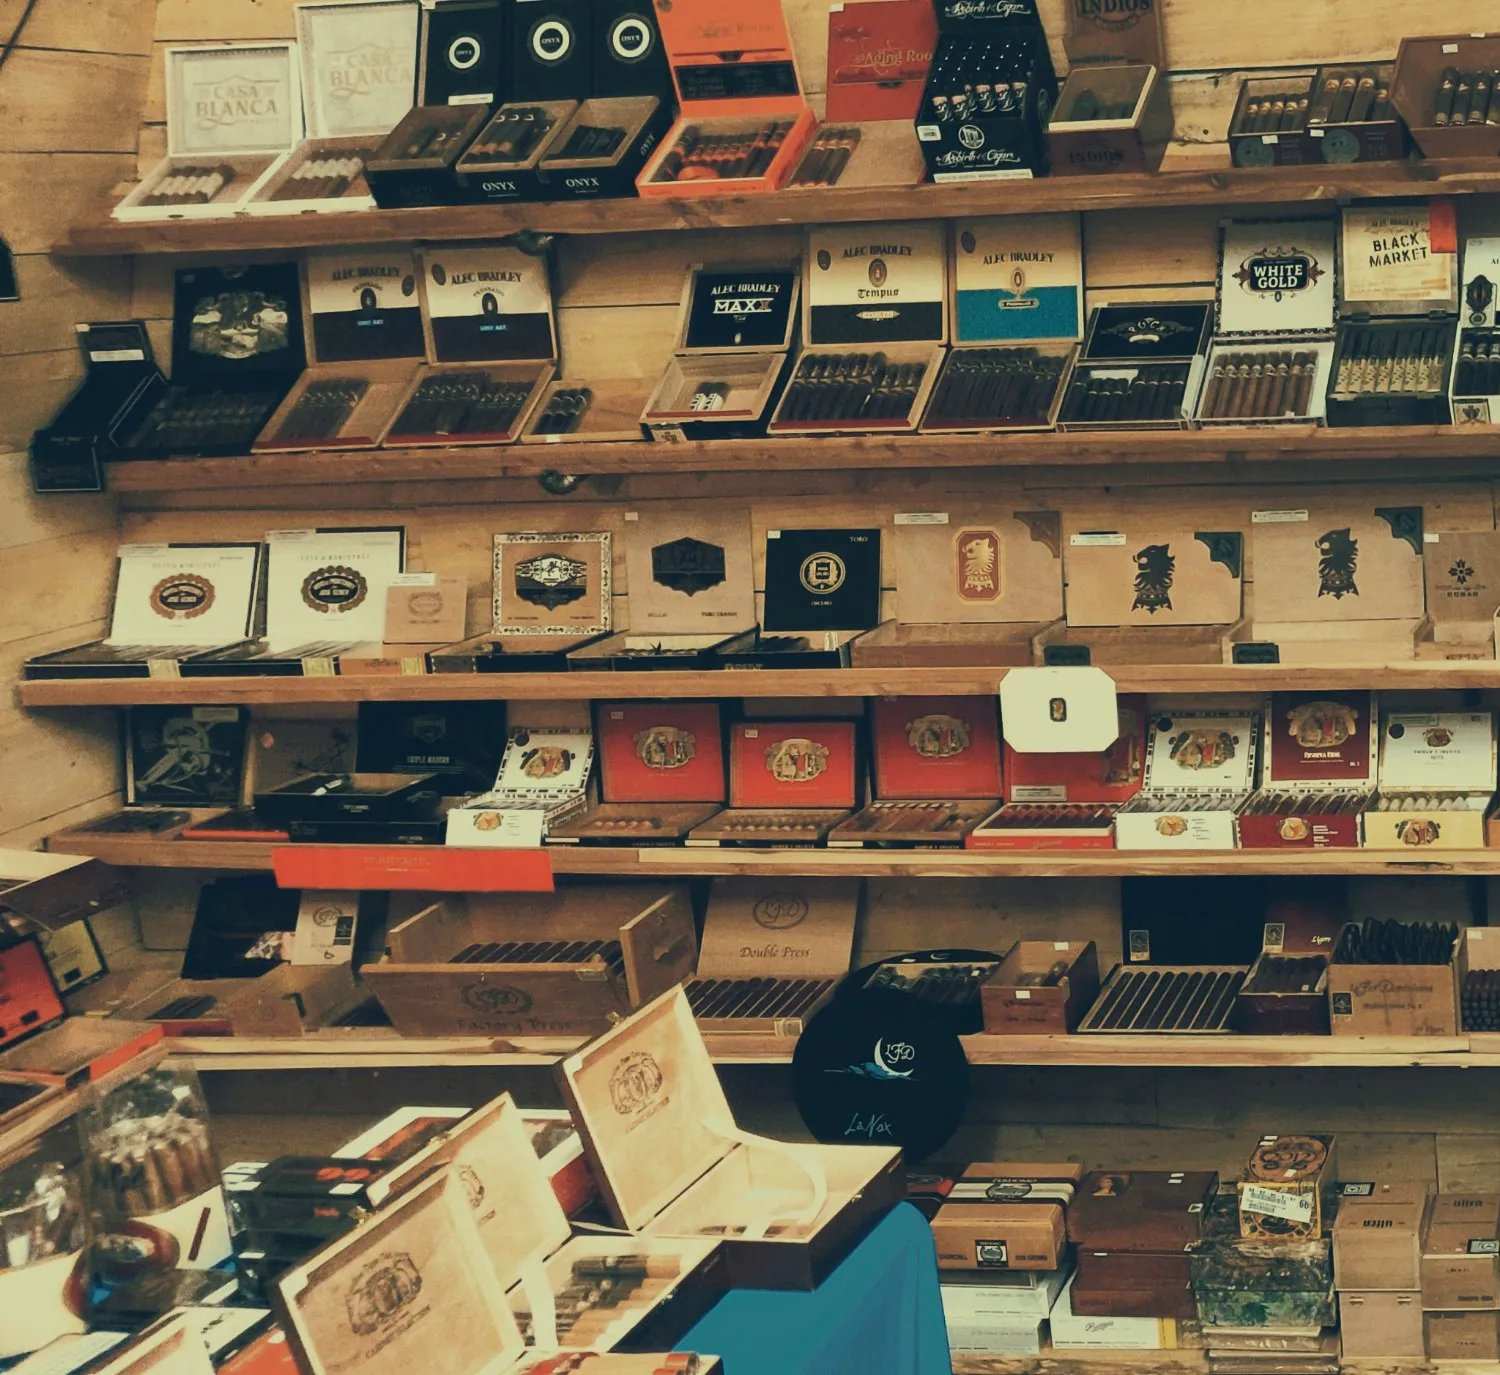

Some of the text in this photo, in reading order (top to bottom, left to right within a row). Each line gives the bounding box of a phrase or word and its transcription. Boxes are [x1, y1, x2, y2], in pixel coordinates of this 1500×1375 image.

[906, 48, 932, 63] Roo
[329, 67, 413, 88] BLANCA
[214, 86, 259, 99] CASA
[196, 100, 278, 118] BLANCA
[482, 181, 516, 191] ONYX
[566, 177, 599, 188] ONYX
[1372, 232, 1419, 252] BLACK
[843, 244, 913, 258] ALEC BRADLEY
[1368, 247, 1428, 268] MARKET
[983, 252, 1055, 266] ALEC BRADLEY
[332, 266, 402, 281] ALEC BRADLEY
[451, 271, 522, 285] ALEC BRADLEY
[1253, 264, 1303, 278] WHITE
[710, 283, 781, 296] ALEC BRADLEY
[1257, 276, 1298, 289] GOLD
[858, 288, 900, 300] Tempus
[740, 944, 811, 959] Double Press
